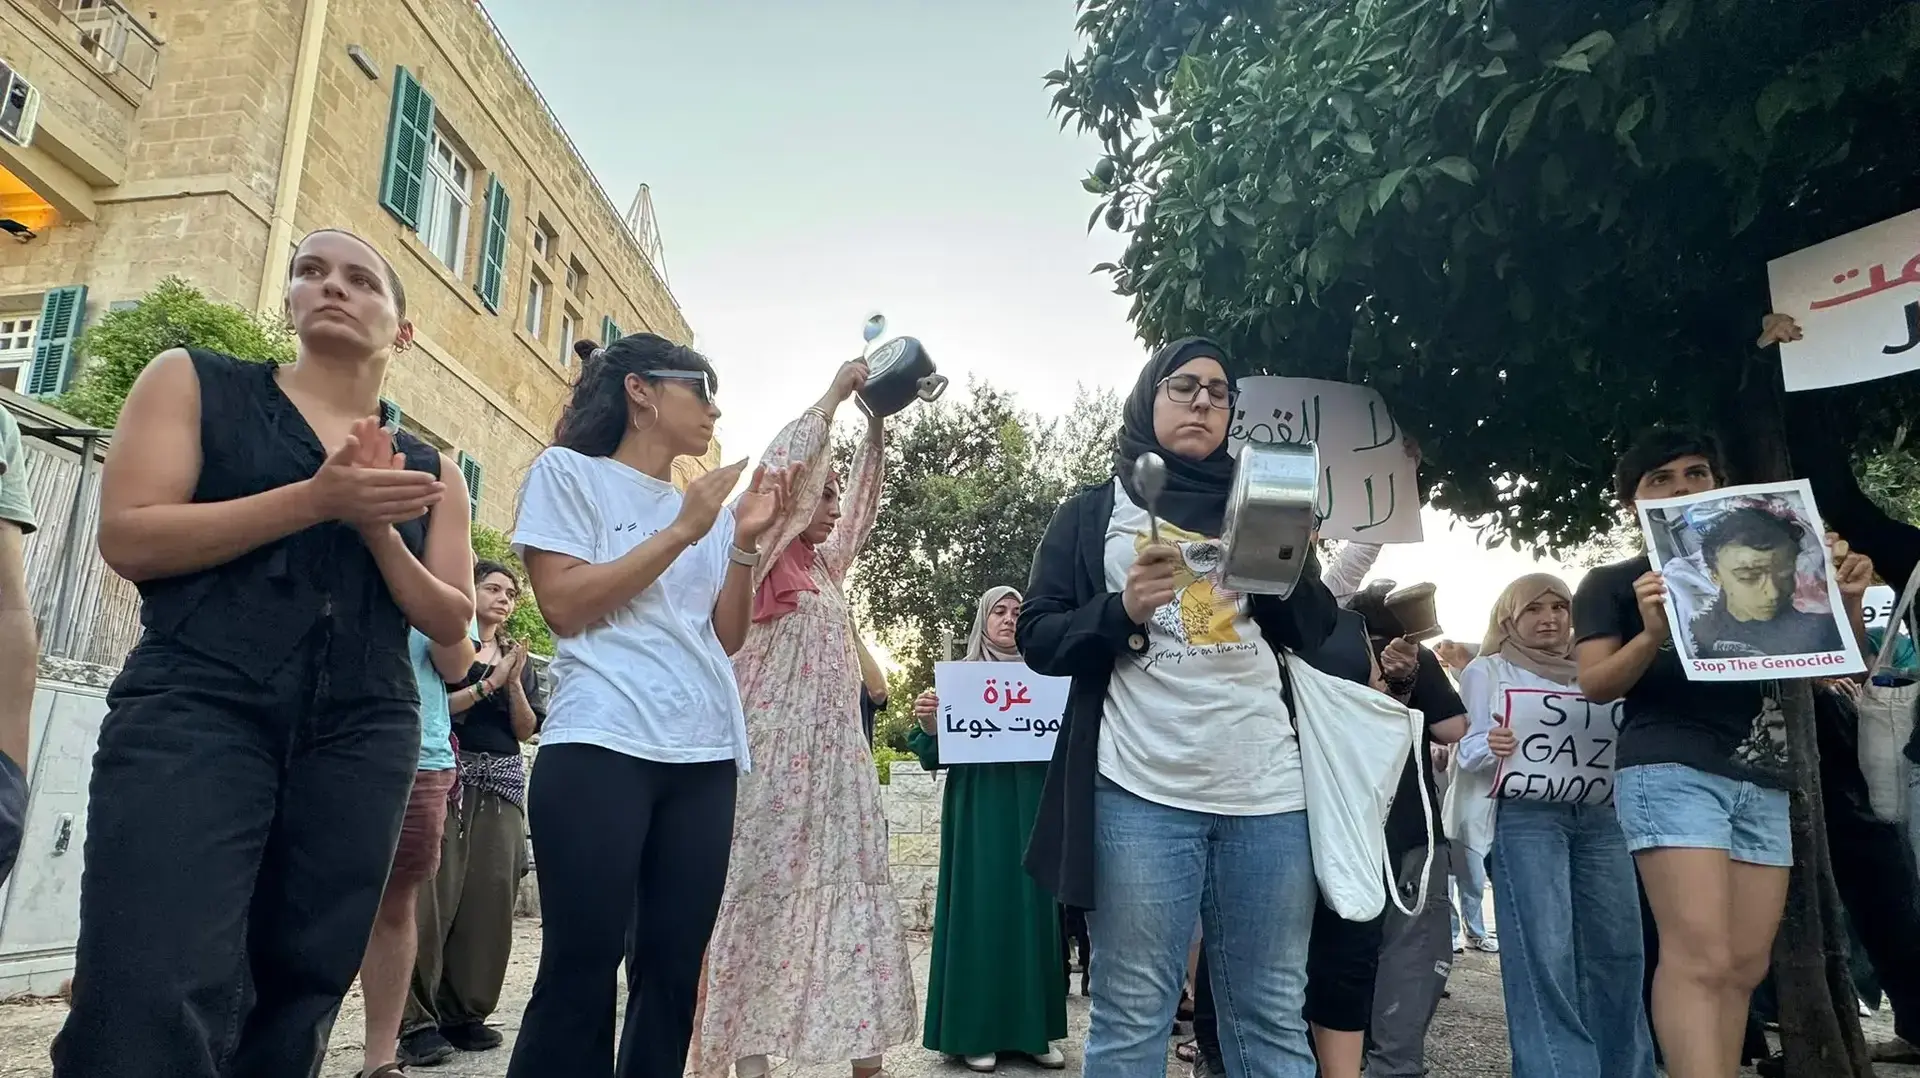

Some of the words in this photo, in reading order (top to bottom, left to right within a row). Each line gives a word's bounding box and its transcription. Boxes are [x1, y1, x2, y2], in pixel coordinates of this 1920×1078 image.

[1352, 401, 1396, 452] لا
[1352, 472, 1395, 532] لا
[1187, 646, 1197, 656] is
[1216, 641, 1233, 655] the
[1234, 642, 1259, 655] way
[1693, 660, 1726, 674] Stop
[1729, 659, 1758, 671] The
[1761, 653, 1845, 669] Genocide
[983, 679, 1032, 712] غزة
[944, 704, 1002, 738] جوعاً
